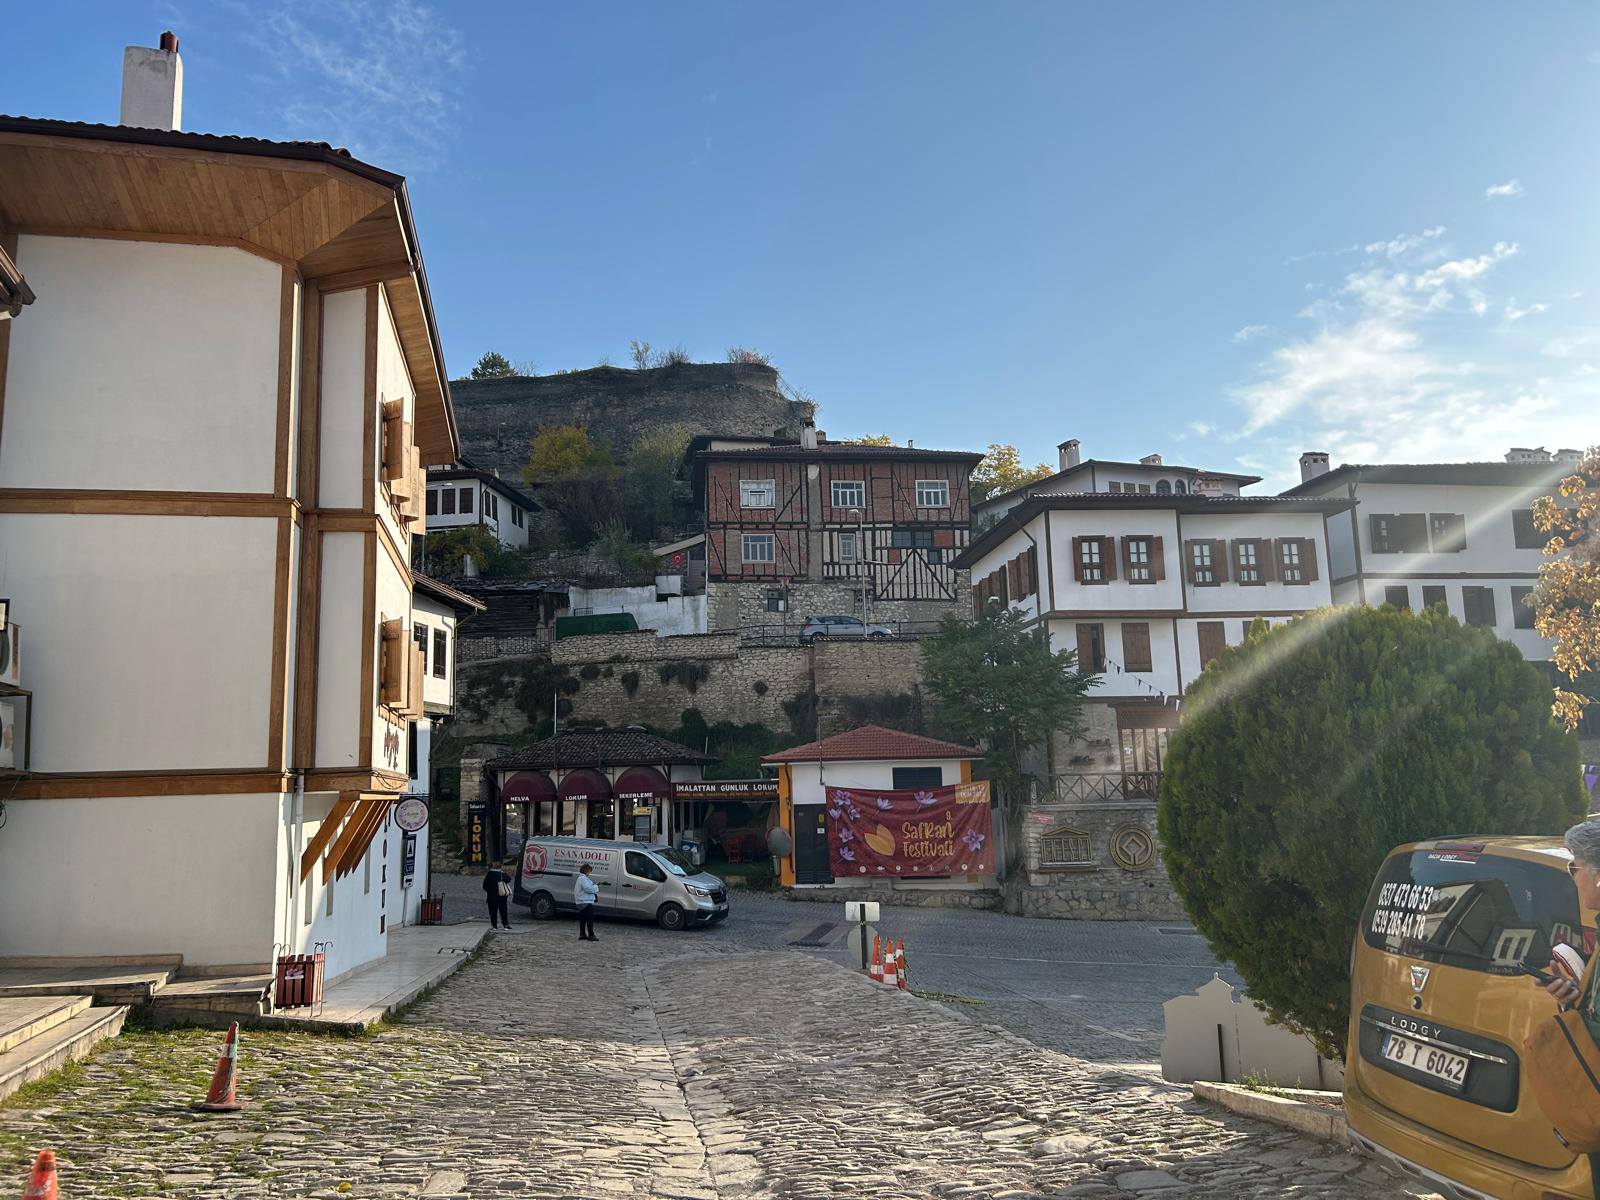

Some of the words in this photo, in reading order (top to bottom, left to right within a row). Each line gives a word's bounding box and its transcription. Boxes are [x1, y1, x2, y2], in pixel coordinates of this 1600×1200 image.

[676, 783, 716, 792] İMALATTAN
[753, 783, 777, 791] LOKUM
[472, 815, 482, 862] LOKUM
[903, 840, 956, 858] Festivali
[554, 849, 611, 861] ESANADOLU
[1378, 883, 1397, 906] 0537
[1394, 884, 1411, 908] 473
[1408, 885, 1421, 909] 66
[1418, 886, 1434, 911] 53
[1371, 909, 1389, 934] 0539
[1387, 911, 1403, 935] 285
[1401, 913, 1413, 937] 41
[1413, 915, 1426, 940] 78
[1391, 1016, 1441, 1038] LODGY
[1387, 1037, 1406, 1060] 78
[1412, 1043, 1422, 1065] T
[1426, 1050, 1465, 1080] 6042
